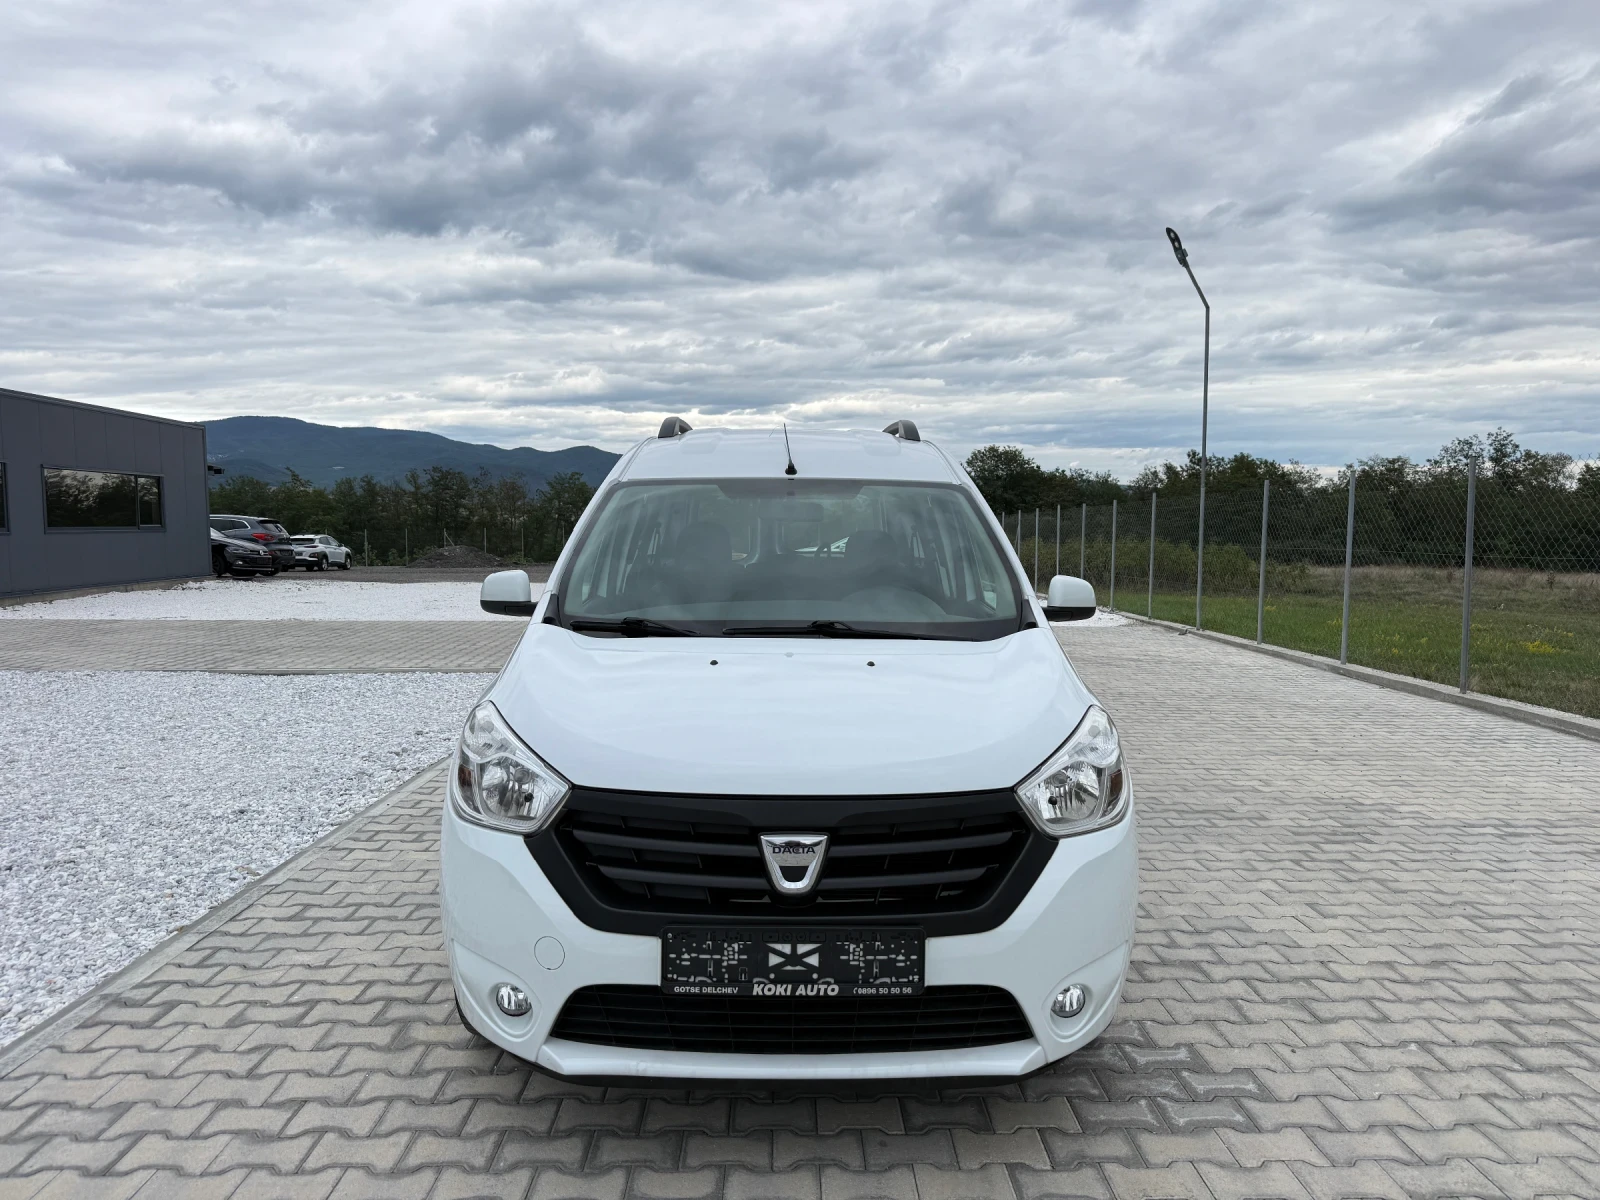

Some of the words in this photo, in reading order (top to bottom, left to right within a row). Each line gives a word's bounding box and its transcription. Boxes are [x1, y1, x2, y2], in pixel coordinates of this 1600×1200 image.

[772, 846, 816, 854] DACIA
[702, 986, 739, 994] DELCHEV
[752, 983, 792, 996] KOKI
[795, 984, 839, 996] AUTO
